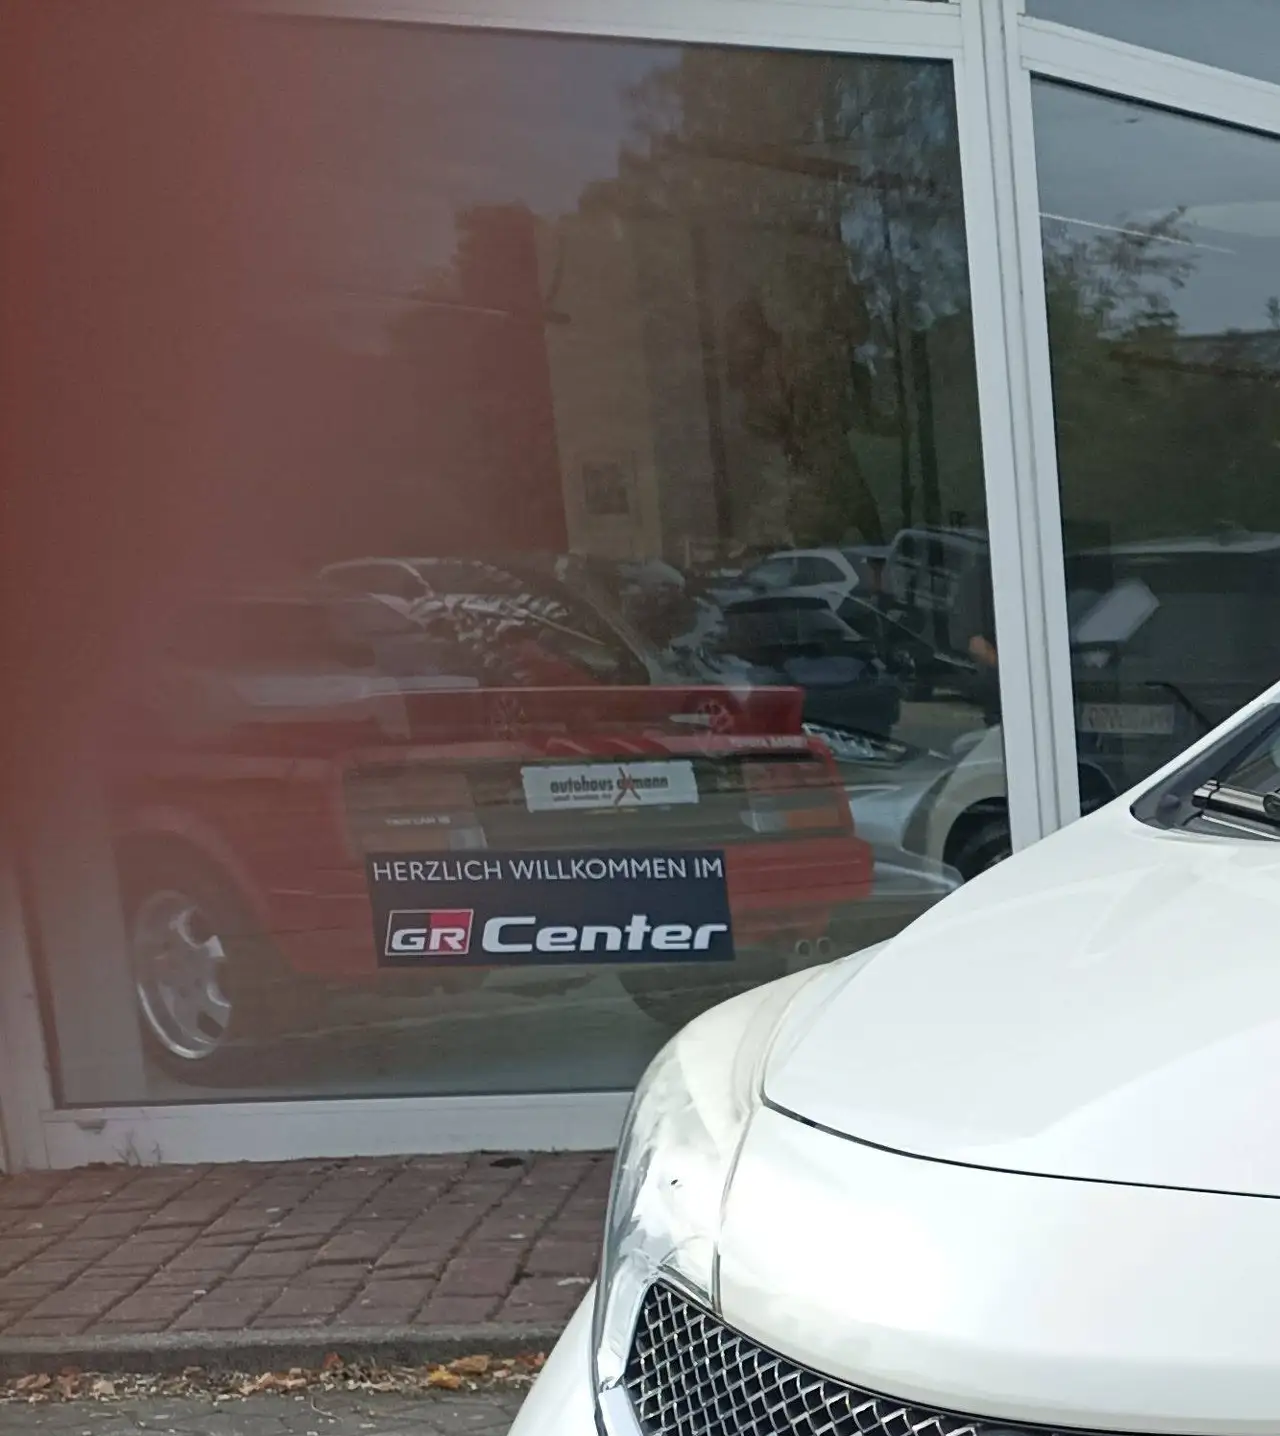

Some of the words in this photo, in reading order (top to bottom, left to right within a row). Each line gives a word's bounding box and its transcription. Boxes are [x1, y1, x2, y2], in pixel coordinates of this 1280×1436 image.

[550, 774, 614, 794] autohaus
[373, 859, 503, 882] HERZLICH
[508, 857, 685, 881] WILLKOMMEN
[694, 856, 724, 879] IM
[391, 928, 467, 951] GR
[481, 914, 728, 952] Center
